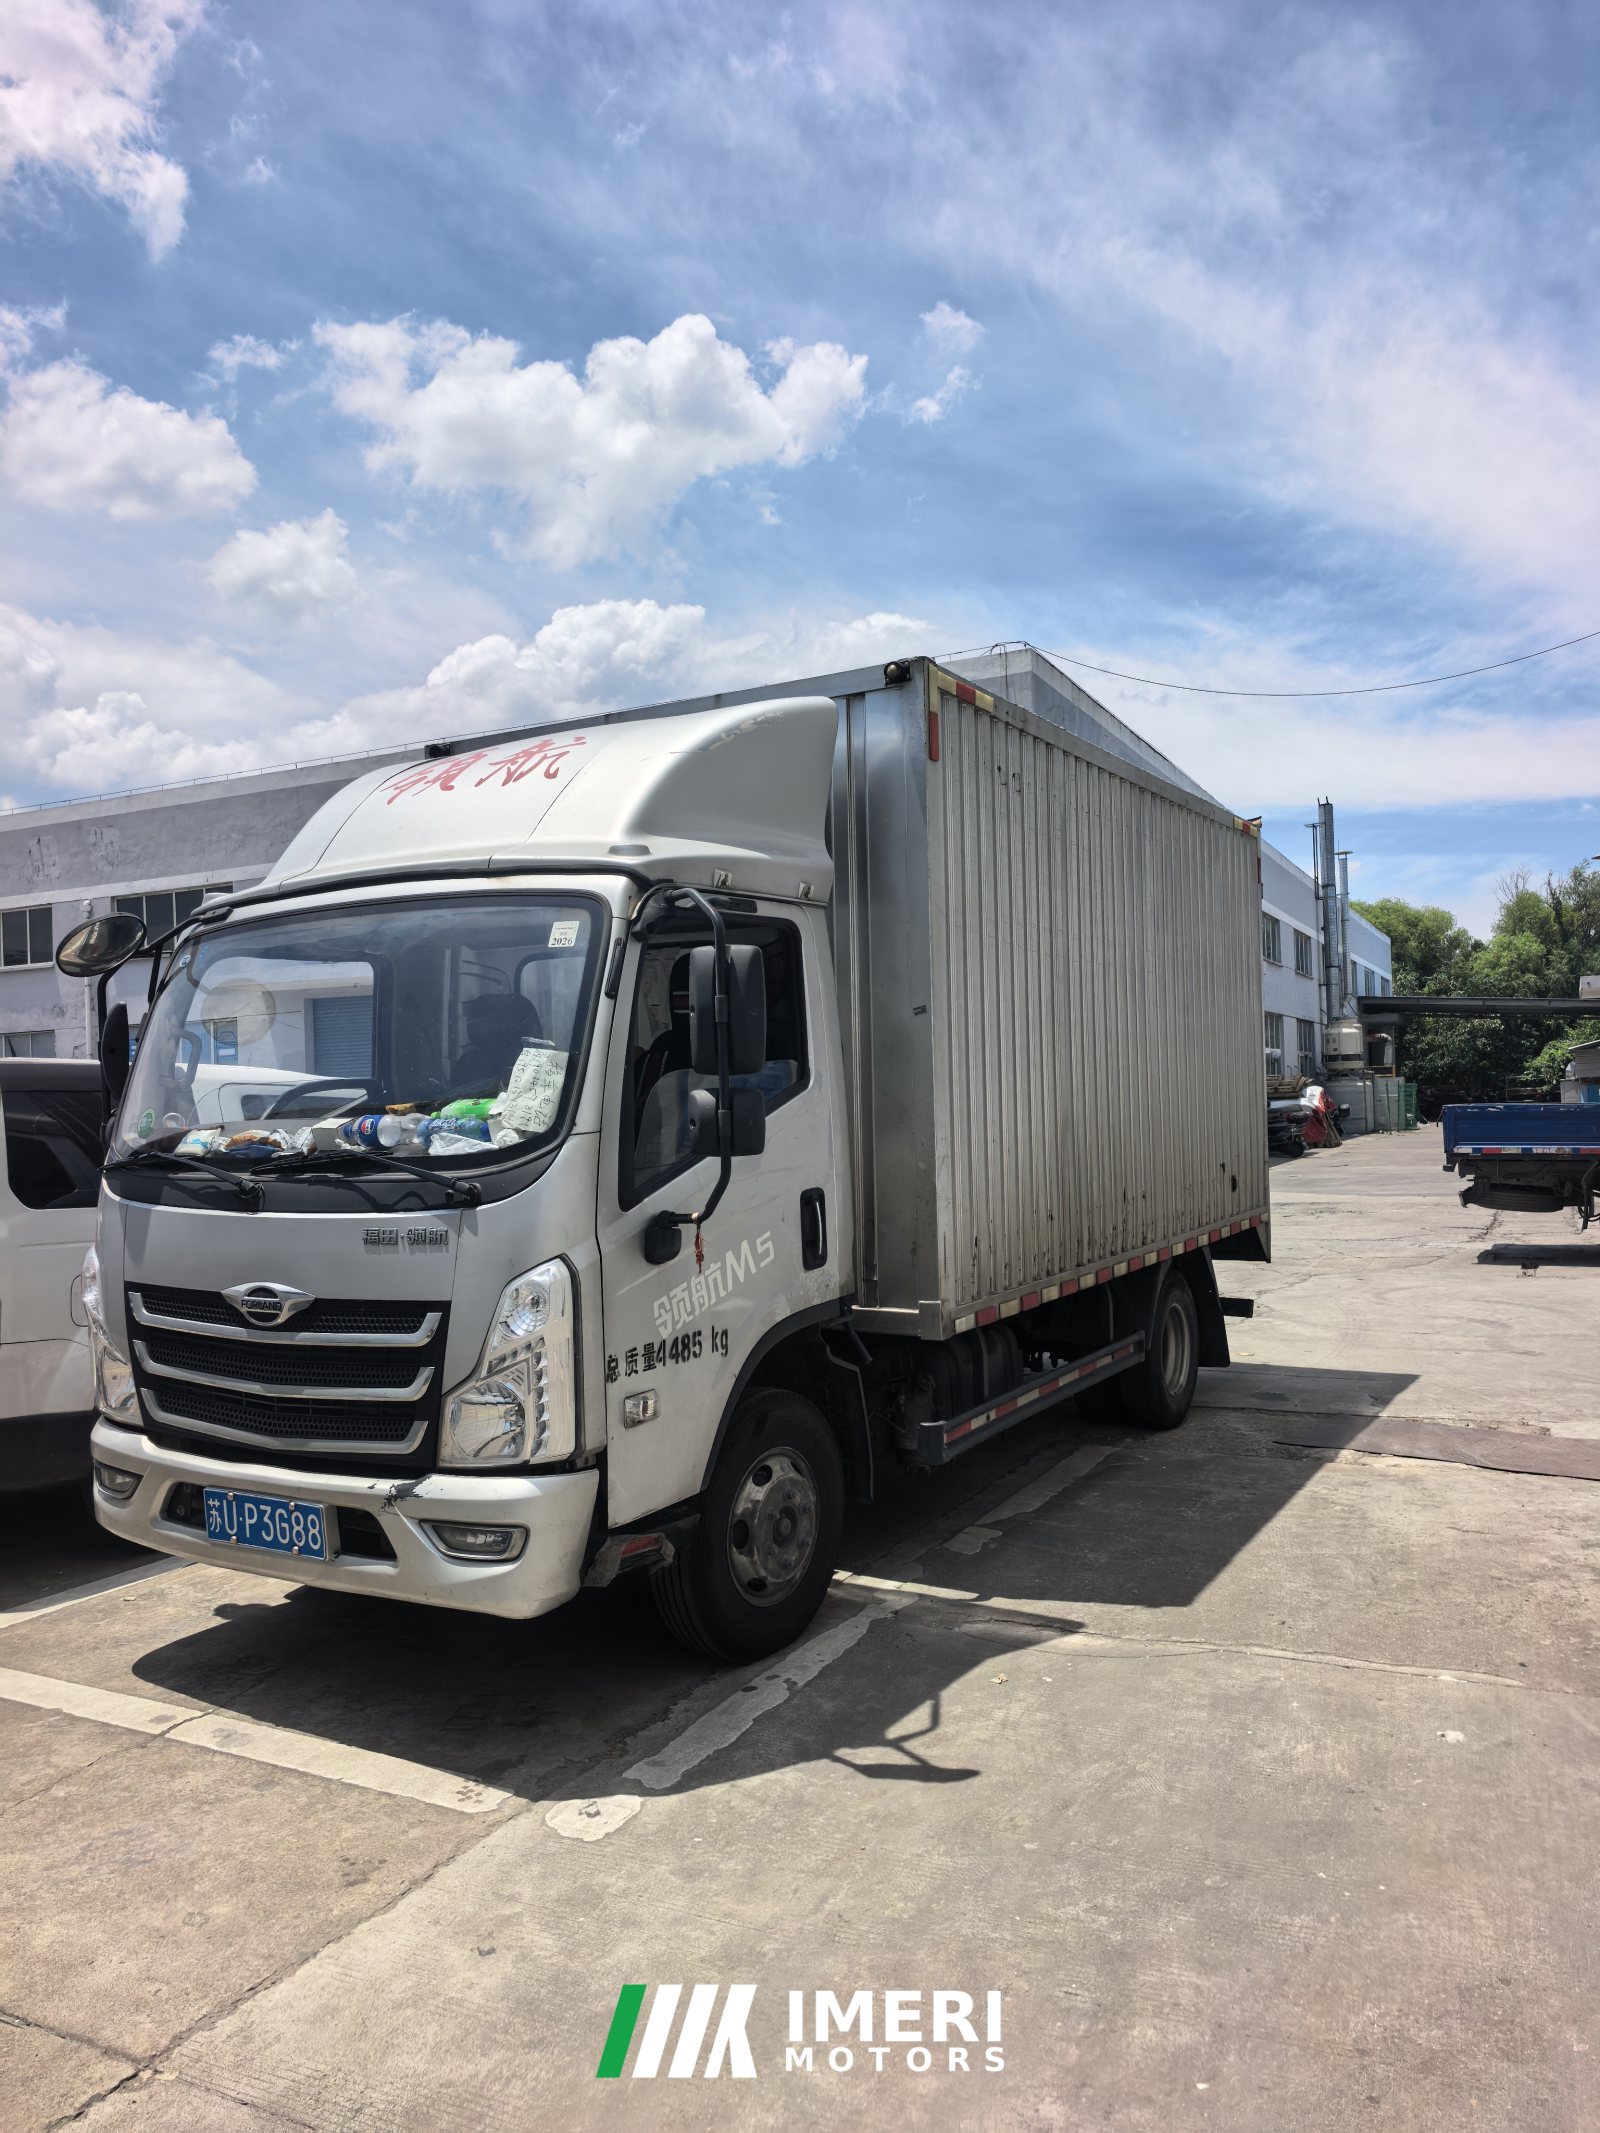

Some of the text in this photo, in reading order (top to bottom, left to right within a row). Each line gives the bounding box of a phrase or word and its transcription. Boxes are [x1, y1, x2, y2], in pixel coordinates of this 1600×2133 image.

[551, 937, 573, 946] 2026
[241, 1300, 282, 1311] FORLAND
[711, 1325, 729, 1357] kg
